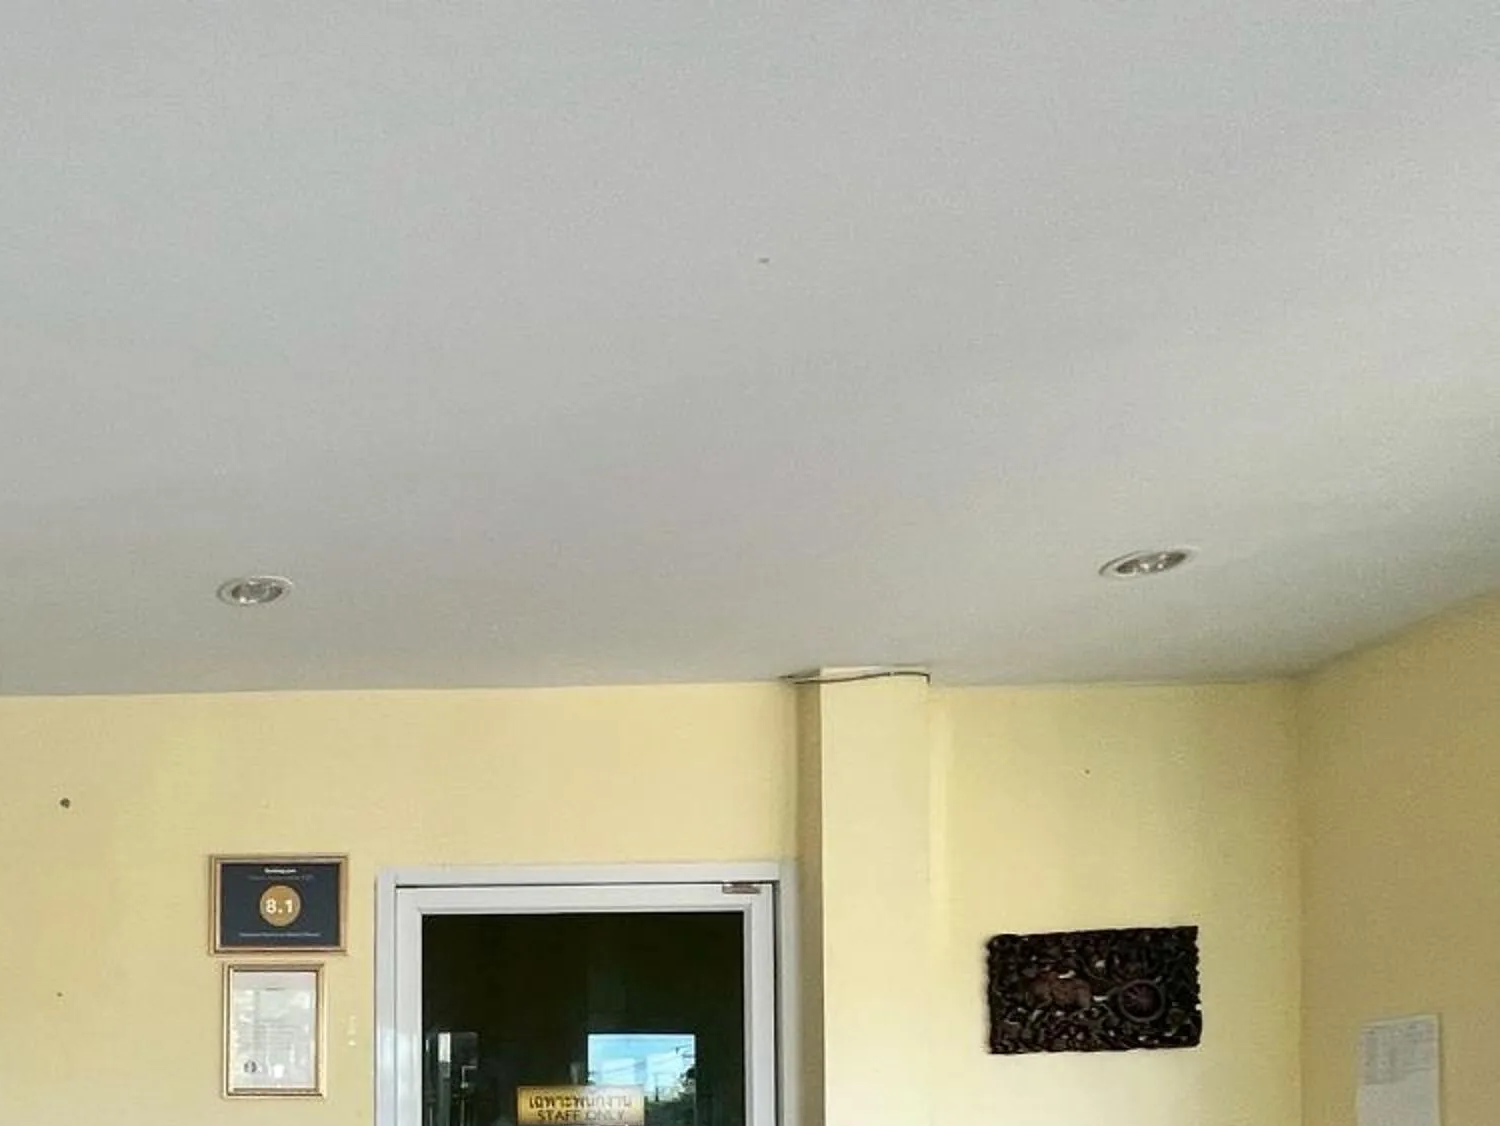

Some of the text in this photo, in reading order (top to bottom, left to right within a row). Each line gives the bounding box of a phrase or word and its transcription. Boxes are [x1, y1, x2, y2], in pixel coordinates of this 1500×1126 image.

[266, 898, 293, 914] 8.1
[537, 1110, 625, 1121] STAFF ONLY
